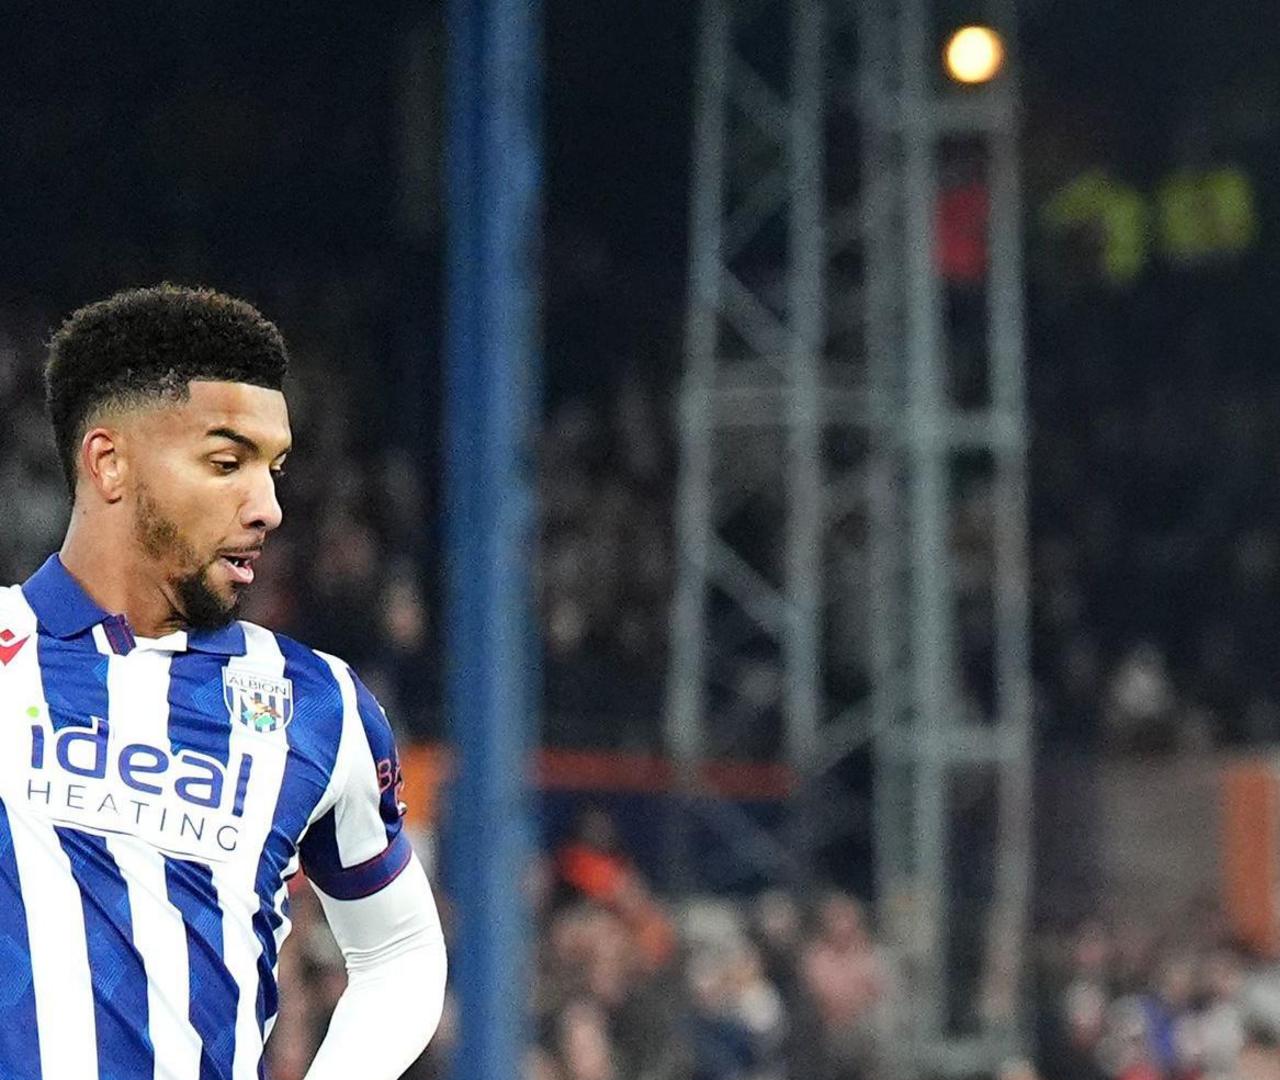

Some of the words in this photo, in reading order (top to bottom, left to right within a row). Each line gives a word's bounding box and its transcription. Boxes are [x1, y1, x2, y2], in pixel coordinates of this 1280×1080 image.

[228, 676, 287, 696] ALBION
[27, 706, 253, 817] ideal
[27, 779, 239, 852] HEATING
